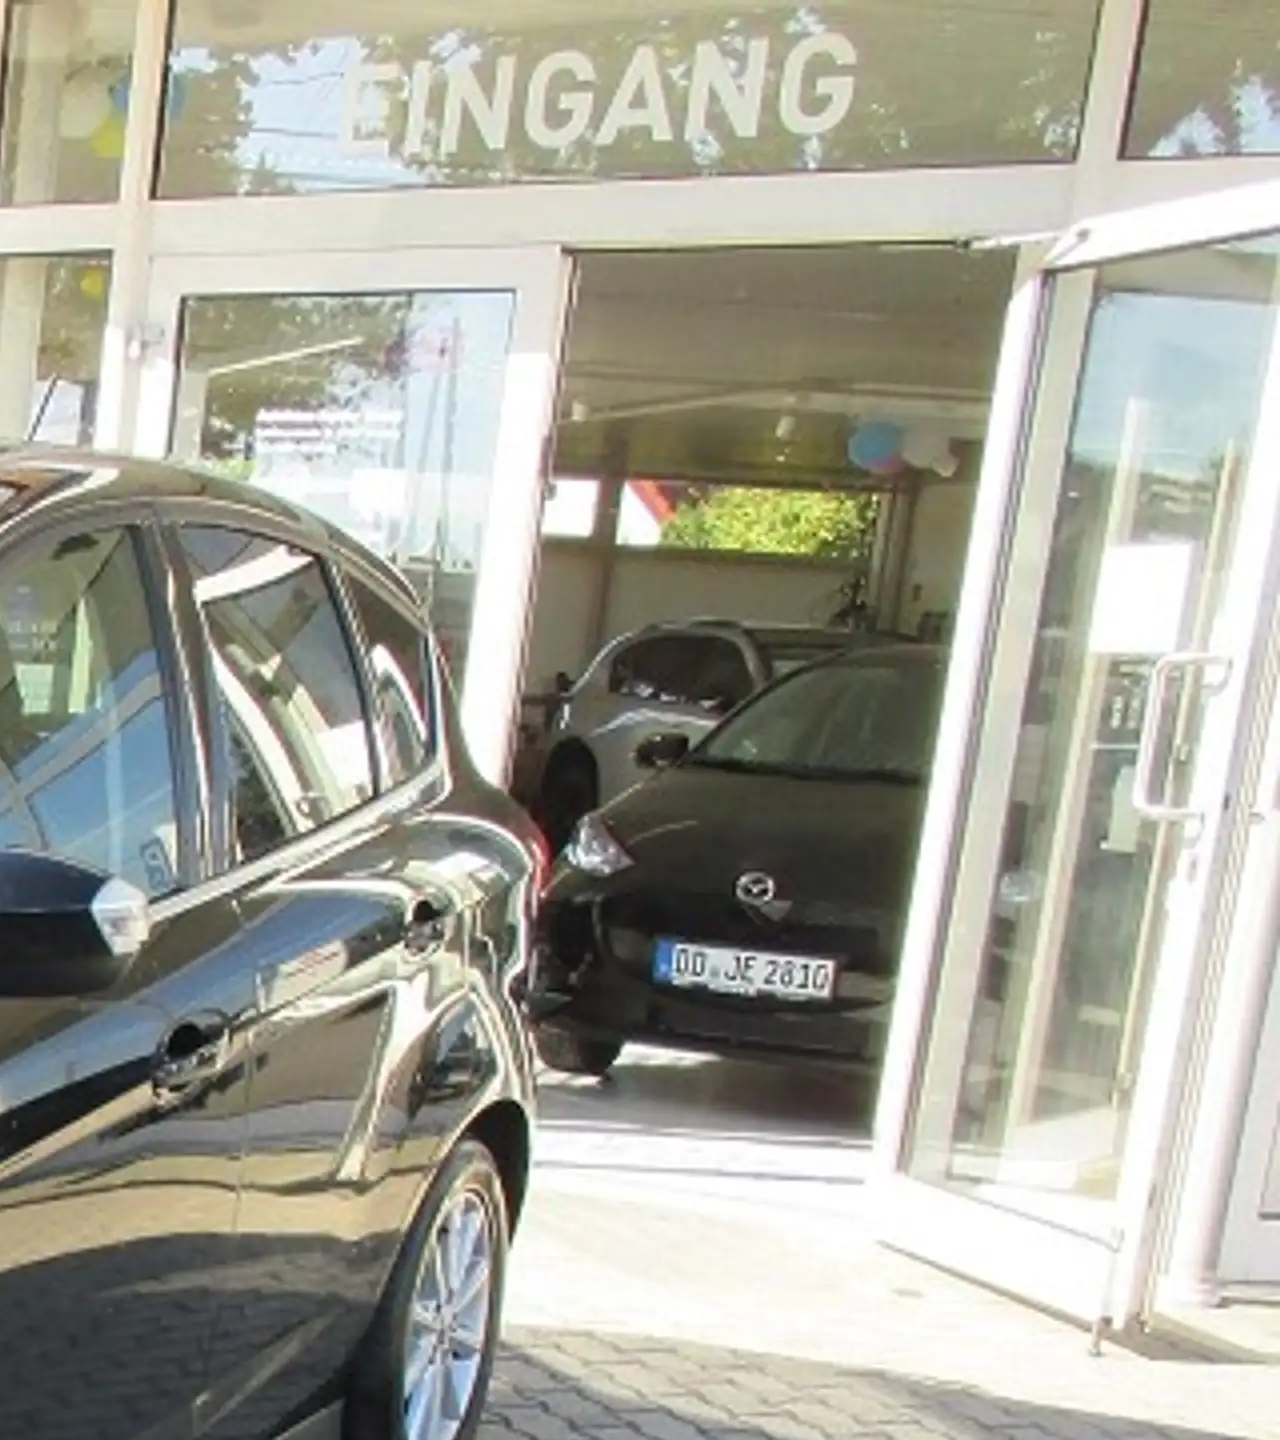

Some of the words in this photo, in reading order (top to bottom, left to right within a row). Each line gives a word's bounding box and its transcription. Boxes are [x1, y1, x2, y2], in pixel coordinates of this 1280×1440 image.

[343, 32, 858, 157] EINGANG
[724, 956, 757, 983] JE
[763, 960, 830, 991] 2810
